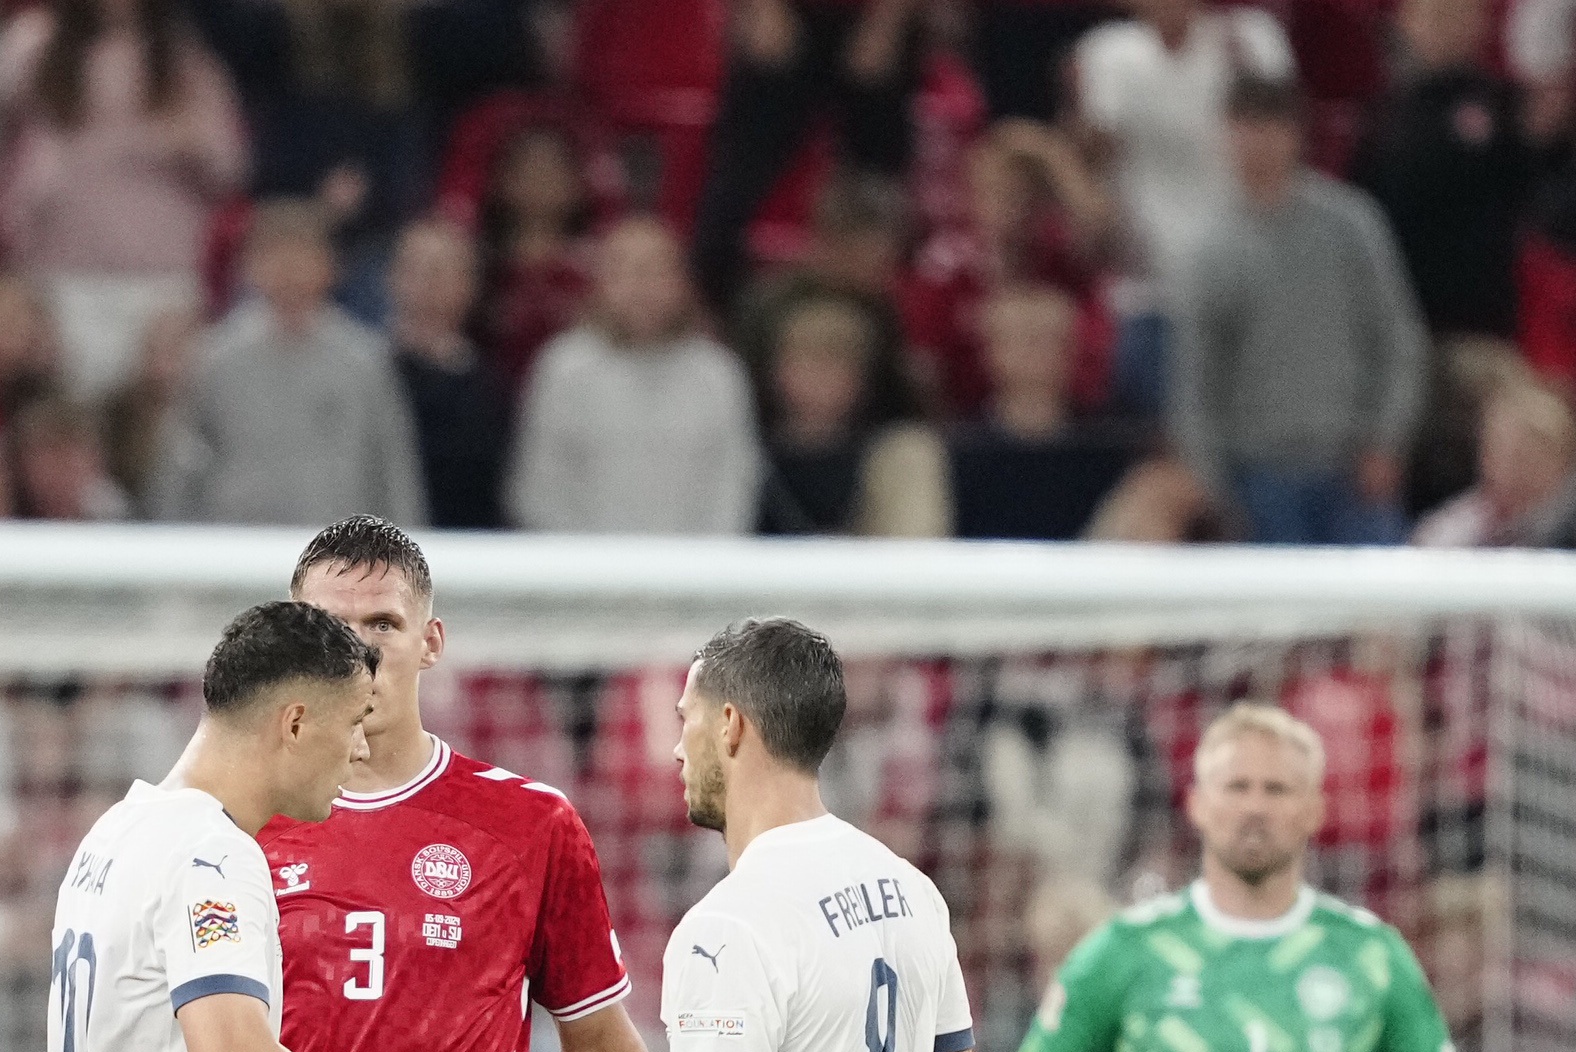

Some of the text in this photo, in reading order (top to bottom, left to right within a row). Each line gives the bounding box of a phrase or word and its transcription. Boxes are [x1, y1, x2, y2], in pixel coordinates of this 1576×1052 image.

[424, 860, 459, 880] DBU
[343, 910, 386, 1000] 3
[679, 1019, 745, 1029] FOUNATION
